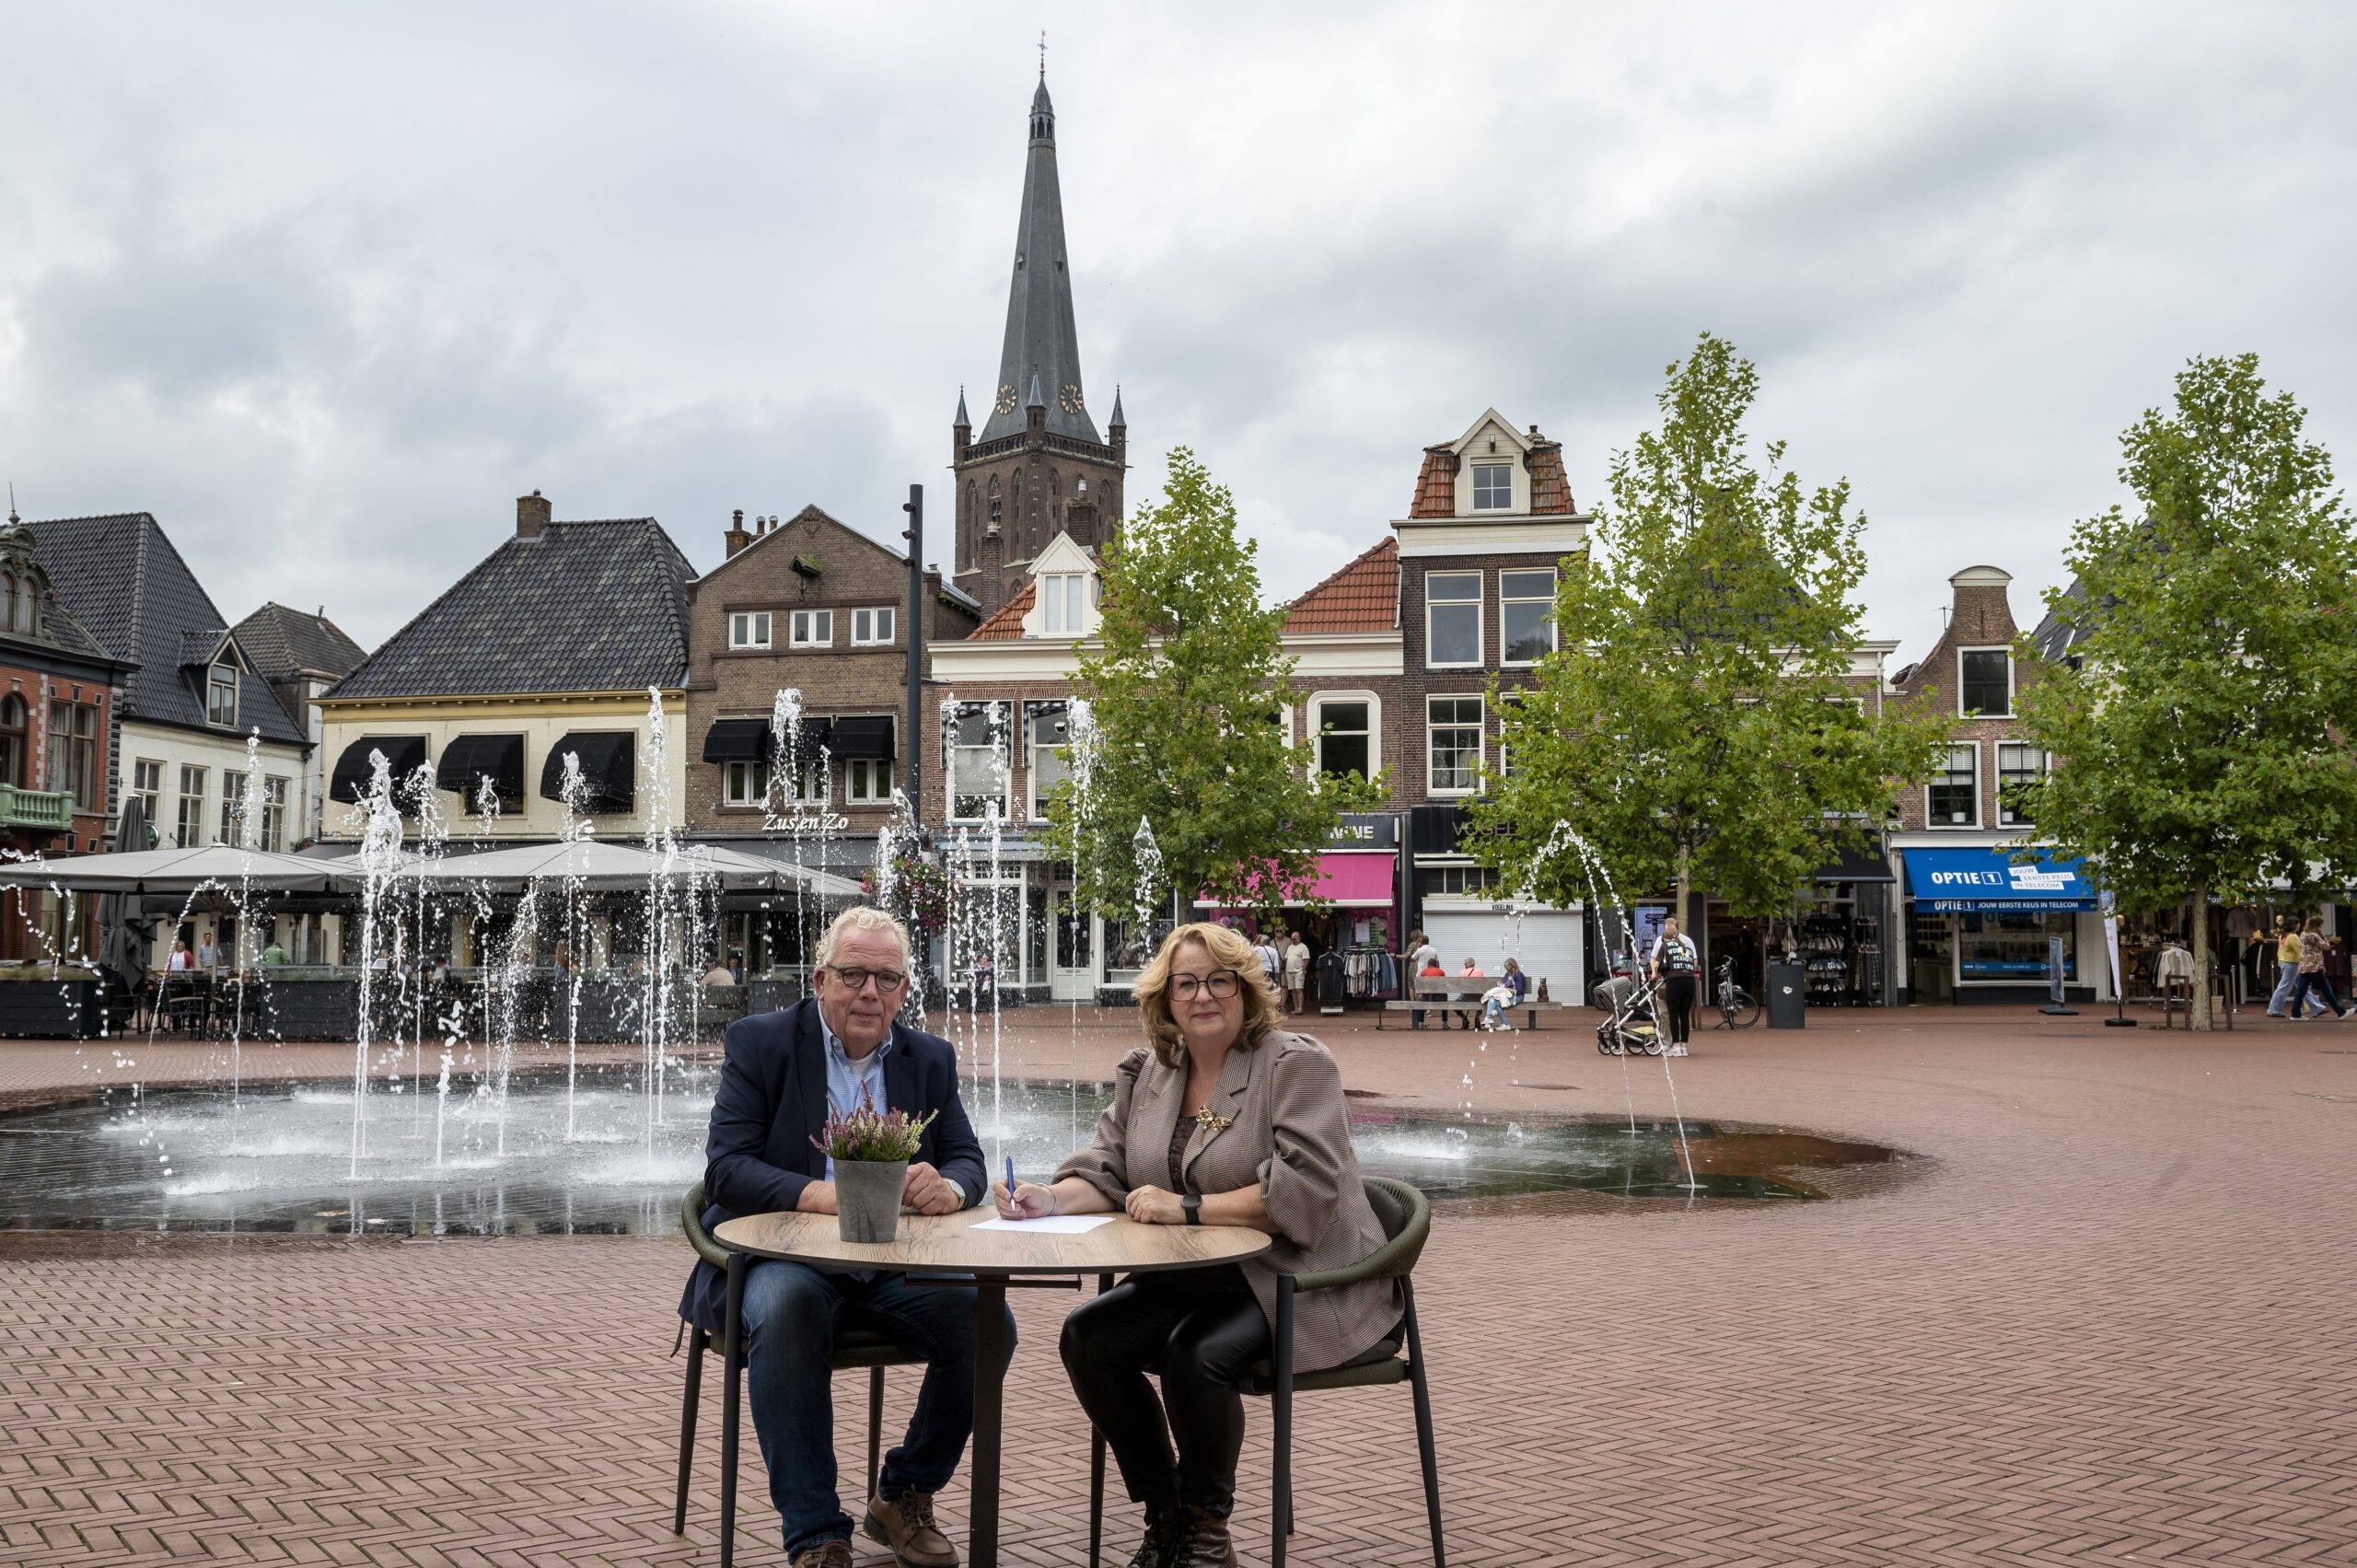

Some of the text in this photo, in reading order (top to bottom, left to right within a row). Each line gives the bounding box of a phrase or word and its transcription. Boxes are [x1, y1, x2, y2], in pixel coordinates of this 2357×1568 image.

[762, 813, 795, 830] Zus
[822, 812, 849, 830] Zo
[1931, 872, 1981, 885] OPTIE
[1934, 900, 1962, 911] OPTIE
